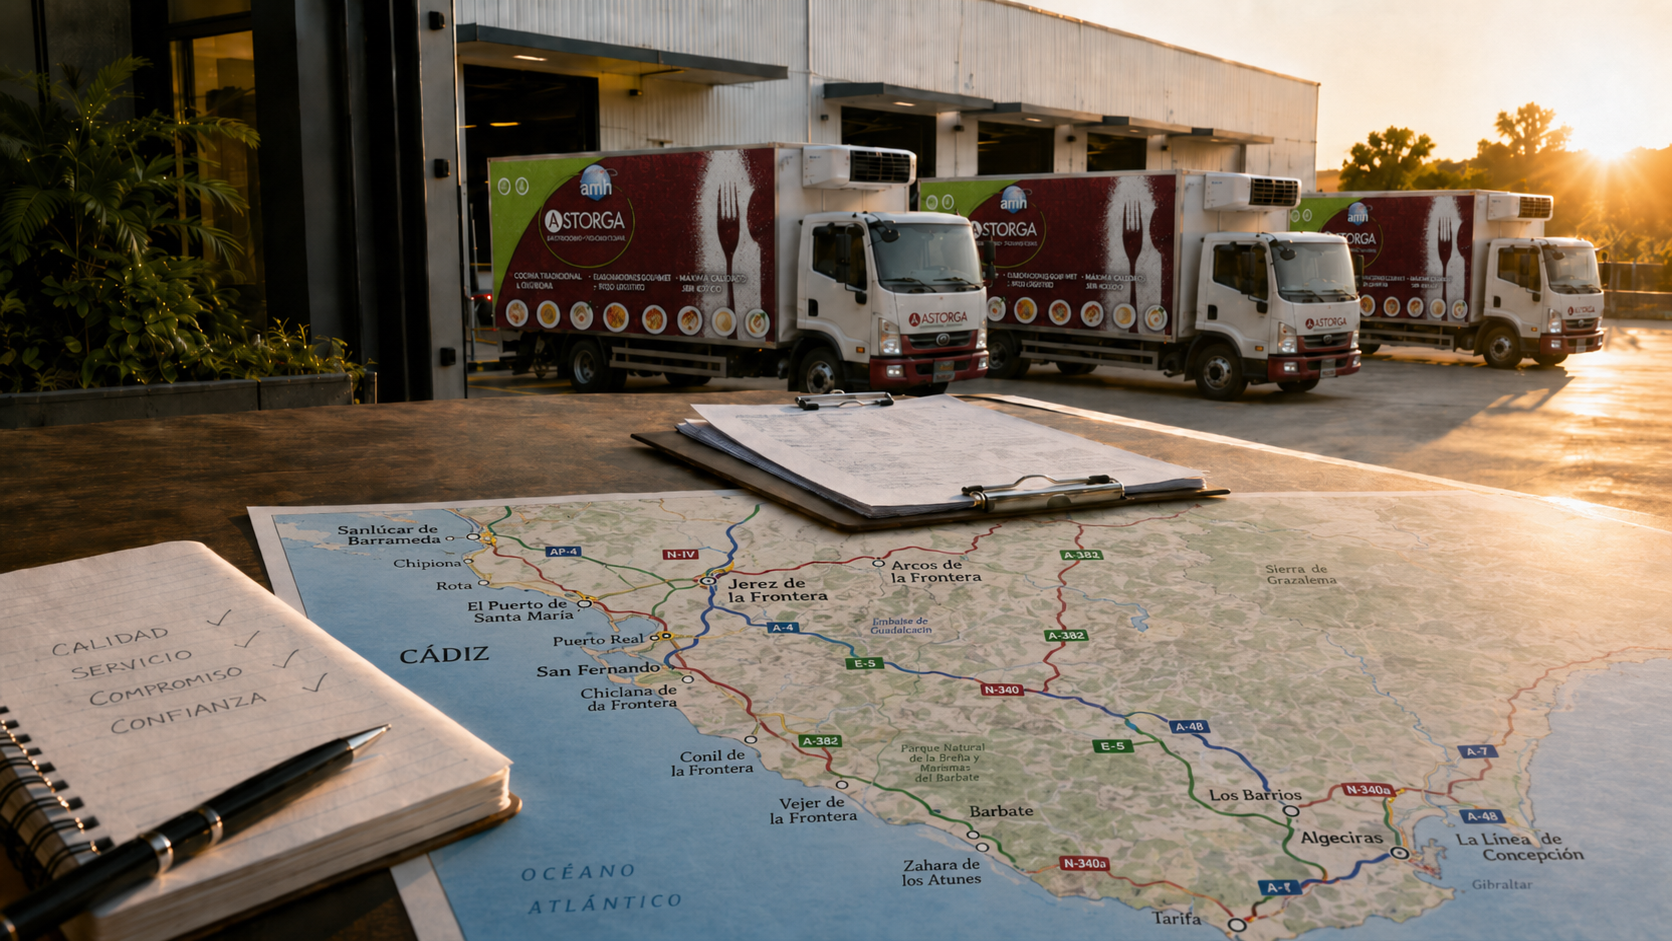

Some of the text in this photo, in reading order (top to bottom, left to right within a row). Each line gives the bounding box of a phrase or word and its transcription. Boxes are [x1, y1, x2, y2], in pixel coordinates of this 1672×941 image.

[580, 180, 612, 196] amh
[545, 210, 625, 233] ASTORGA
[922, 311, 968, 324] ASTORGA
[338, 524, 438, 536] Sanlúcar de
[348, 535, 441, 546] Barrameda
[550, 548, 577, 556] AP-4
[667, 550, 695, 559] N-IV
[394, 558, 462, 571] Chipiona
[892, 560, 962, 570] Arcos de
[1266, 564, 1328, 574] Sierra de
[892, 572, 982, 583] la Frontera
[1267, 576, 1338, 585] Grazalema
[436, 581, 472, 590] Rota
[728, 578, 806, 591] Jerez de
[728, 590, 828, 603] la Frontera
[468, 599, 568, 611] El Puerto de
[474, 610, 574, 623] Santa María
[916, 616, 928, 625] de
[772, 624, 794, 632] A-4
[52, 627, 168, 657] CALIDAD
[553, 634, 644, 647] Puerto Real
[1049, 632, 1086, 640] A-382
[400, 644, 490, 664] CÁDIZ
[71, 650, 192, 680] SERVICIO
[536, 662, 660, 678] San Fernando
[89, 666, 242, 706] COMPROMISO
[581, 684, 677, 699] Chiclana de
[985, 686, 1019, 694] N-340
[588, 698, 678, 712] da Frontera
[110, 692, 267, 734] CONFIANZA
[802, 736, 838, 746] A-382
[1101, 741, 1125, 750] E-5
[901, 743, 985, 754] Parque Natural
[1468, 747, 1487, 756] A-7
[680, 750, 746, 763] Conil de
[910, 754, 922, 762] de
[926, 754, 936, 762] la
[974, 754, 980, 764] y
[671, 763, 754, 777] la Frontera
[915, 773, 980, 782] del Barbate
[1210, 789, 1302, 801] Los Barrios
[1346, 785, 1391, 796] N-340a
[780, 796, 845, 812] Vejer de
[770, 810, 858, 825] la Frontera
[970, 805, 1034, 818] Barbate
[1301, 832, 1384, 848] Algeciras
[1456, 832, 1562, 846] La Línea de
[1483, 848, 1584, 864] Concepción
[903, 858, 980, 872] Zahara de
[1064, 858, 1106, 868] N-340a
[521, 863, 635, 882] OCÉANO
[902, 873, 982, 887] los Atunes
[1472, 878, 1534, 890] Gibraltar
[528, 894, 682, 914] ATLÁNTICO
[1152, 911, 1202, 926] Tarifa
